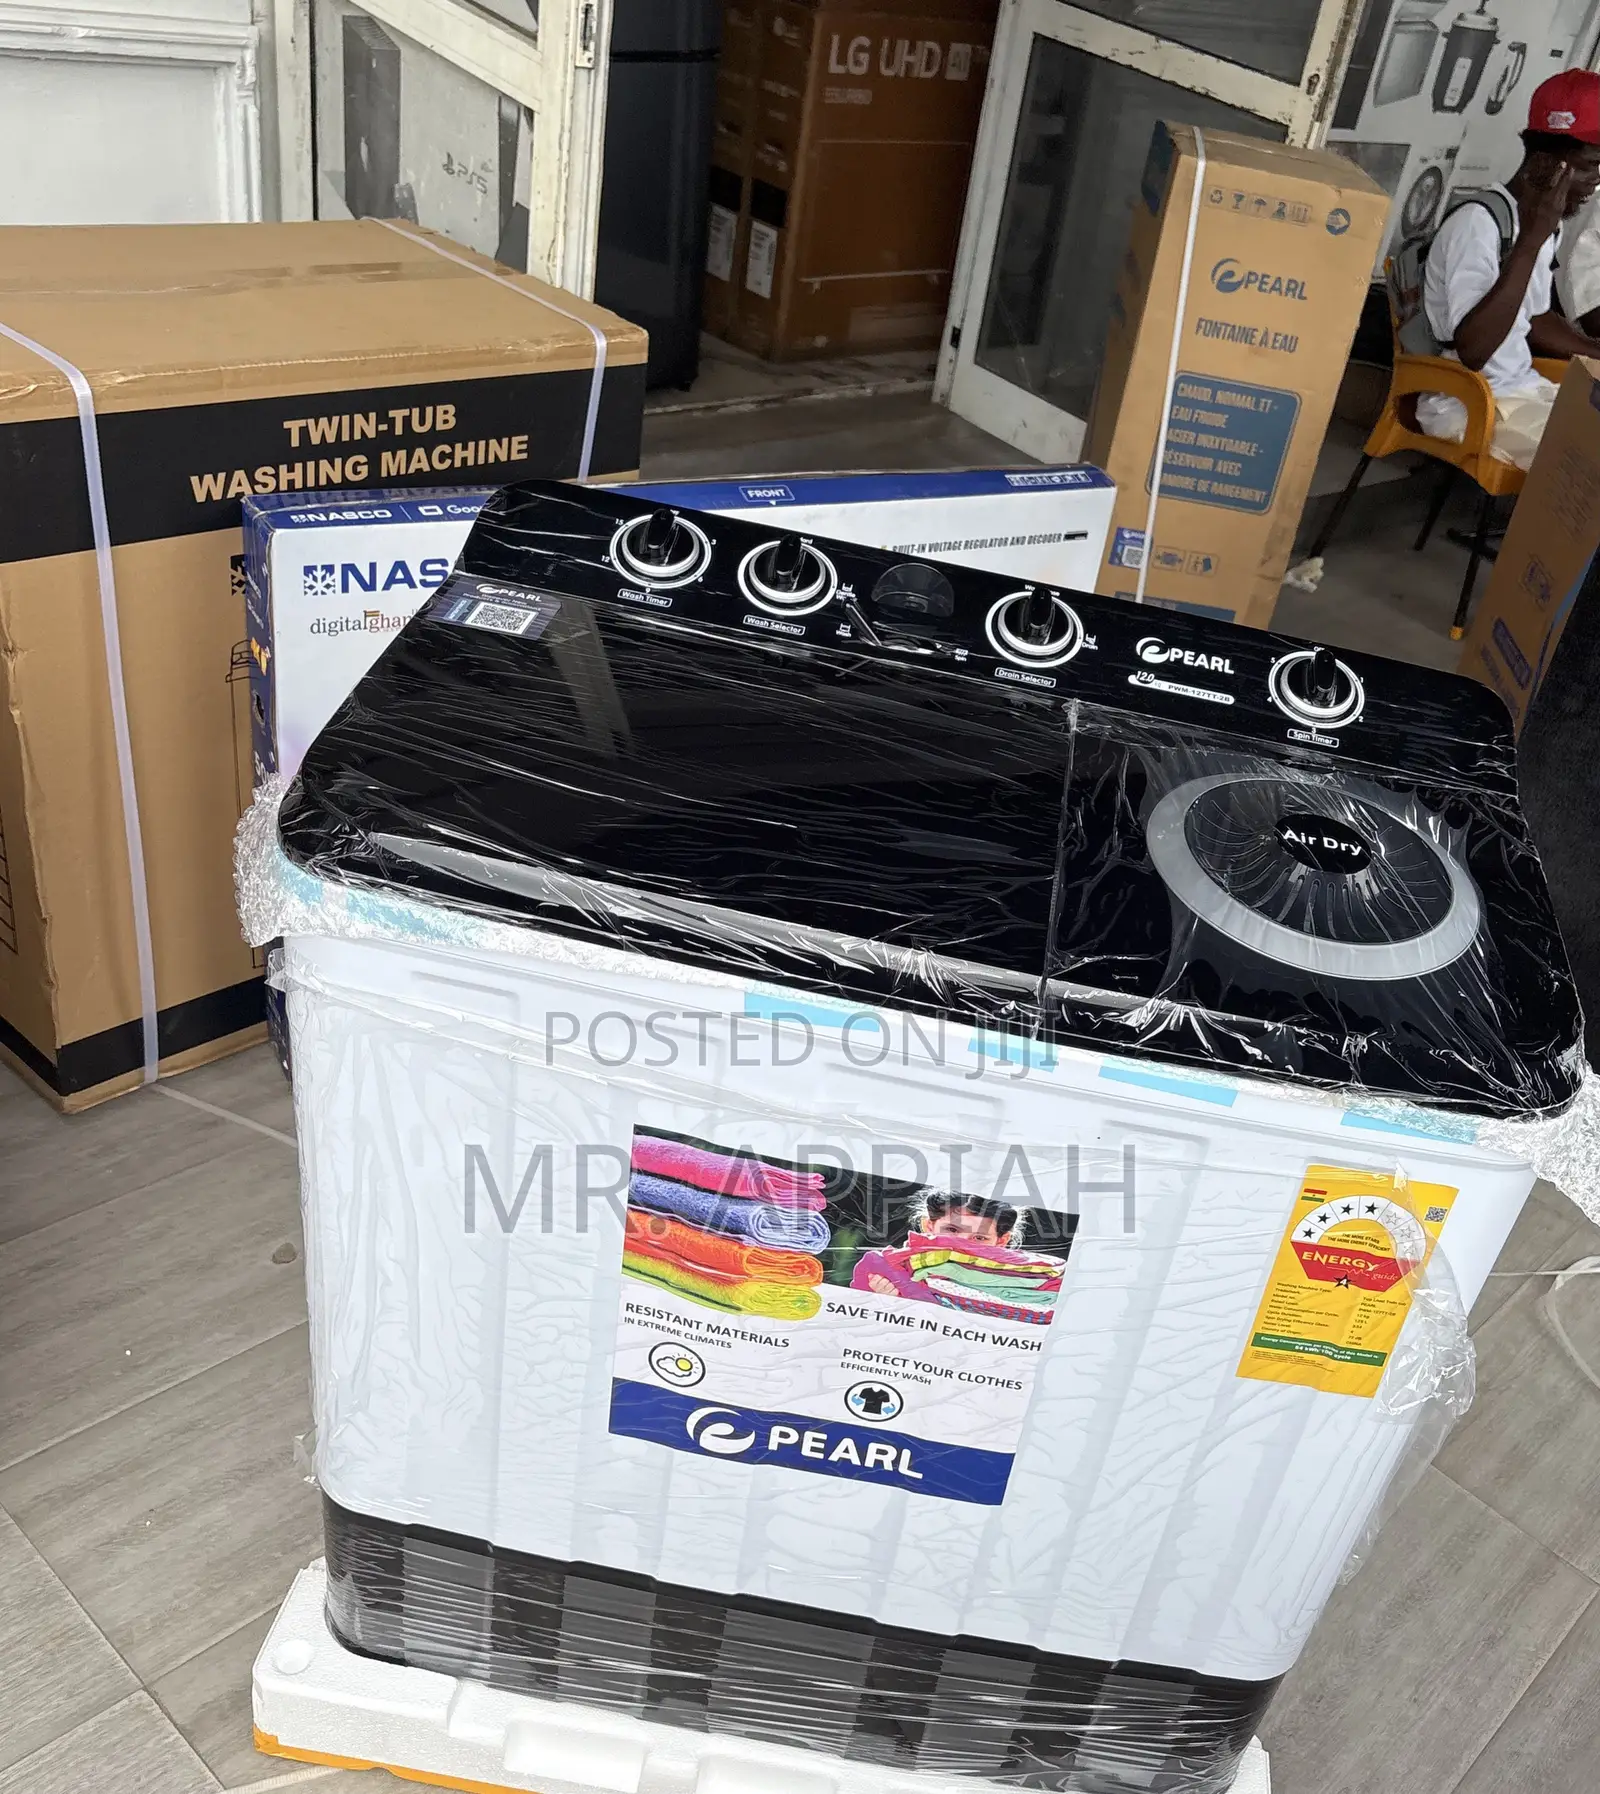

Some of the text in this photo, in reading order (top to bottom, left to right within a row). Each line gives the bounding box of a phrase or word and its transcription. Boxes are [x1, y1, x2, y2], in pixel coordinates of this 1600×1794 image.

[827, 34, 872, 75] LG
[879, 38, 941, 78] UHD
[1244, 271, 1308, 300] PEARL
[1195, 317, 1259, 346] FONTAINE
[1270, 332, 1299, 354] EAU
[283, 404, 457, 447] TWIN-TUB
[190, 435, 530, 503] WASHING MACHINE
[747, 487, 786, 499] FRONT
[305, 508, 393, 523] NASCO
[446, 504, 481, 515] Goo
[615, 518, 624, 526] 15
[928, 540, 963, 553] VOLTAGE
[964, 537, 1009, 551] REGULATOR
[1009, 536, 1027, 548] AND
[1027, 532, 1064, 546] DECODER
[601, 555, 610, 563] 12
[499, 588, 543, 602] PEARL
[621, 590, 668, 606] Wash Timer
[746, 616, 802, 634] Wash Selector
[1081, 643, 1099, 651] Drain
[1169, 647, 1235, 675] PEARL
[998, 669, 1053, 686] Drain Selector
[1293, 731, 1333, 745] Spin Timer
[1284, 829, 1362, 856] Air Dry
[1302, 1250, 1384, 1272] ENERGY
[1371, 1271, 1399, 1281] guide
[624, 1316, 732, 1349] IN EXTREME CLIMATES
[625, 1302, 790, 1348] RESISTANT MATERIALS
[826, 1302, 1043, 1352] SAVE TIME IN EACH WASH
[840, 1361, 932, 1386] EFFICIENTLY WASH
[842, 1348, 1023, 1391] PROTECT YOUR CLOTHES
[767, 1425, 924, 1479] PEARL
